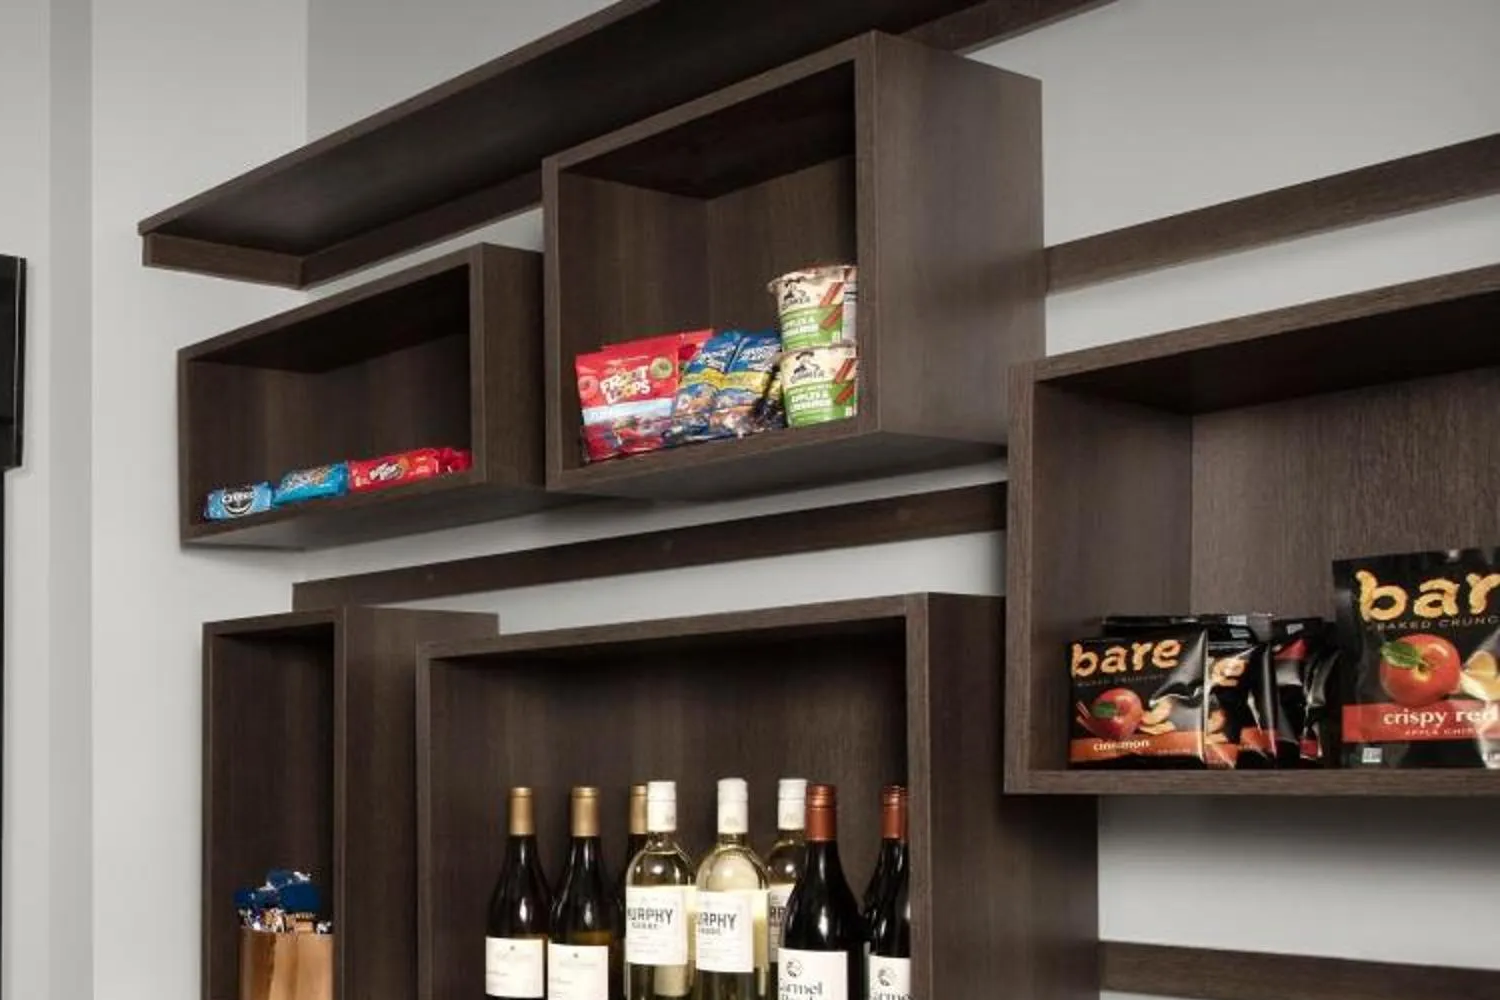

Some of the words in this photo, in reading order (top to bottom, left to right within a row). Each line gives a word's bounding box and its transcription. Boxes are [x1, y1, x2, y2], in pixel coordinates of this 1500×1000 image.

[1355, 569, 1500, 622] bar
[1438, 617, 1500, 629] CRUNC
[1071, 639, 1181, 678] bare
[1383, 708, 1447, 727] crispy
[1455, 705, 1498, 723] red
[627, 907, 673, 926] URPHY
[700, 911, 738, 931] RPHY
[779, 981, 823, 996] armel
